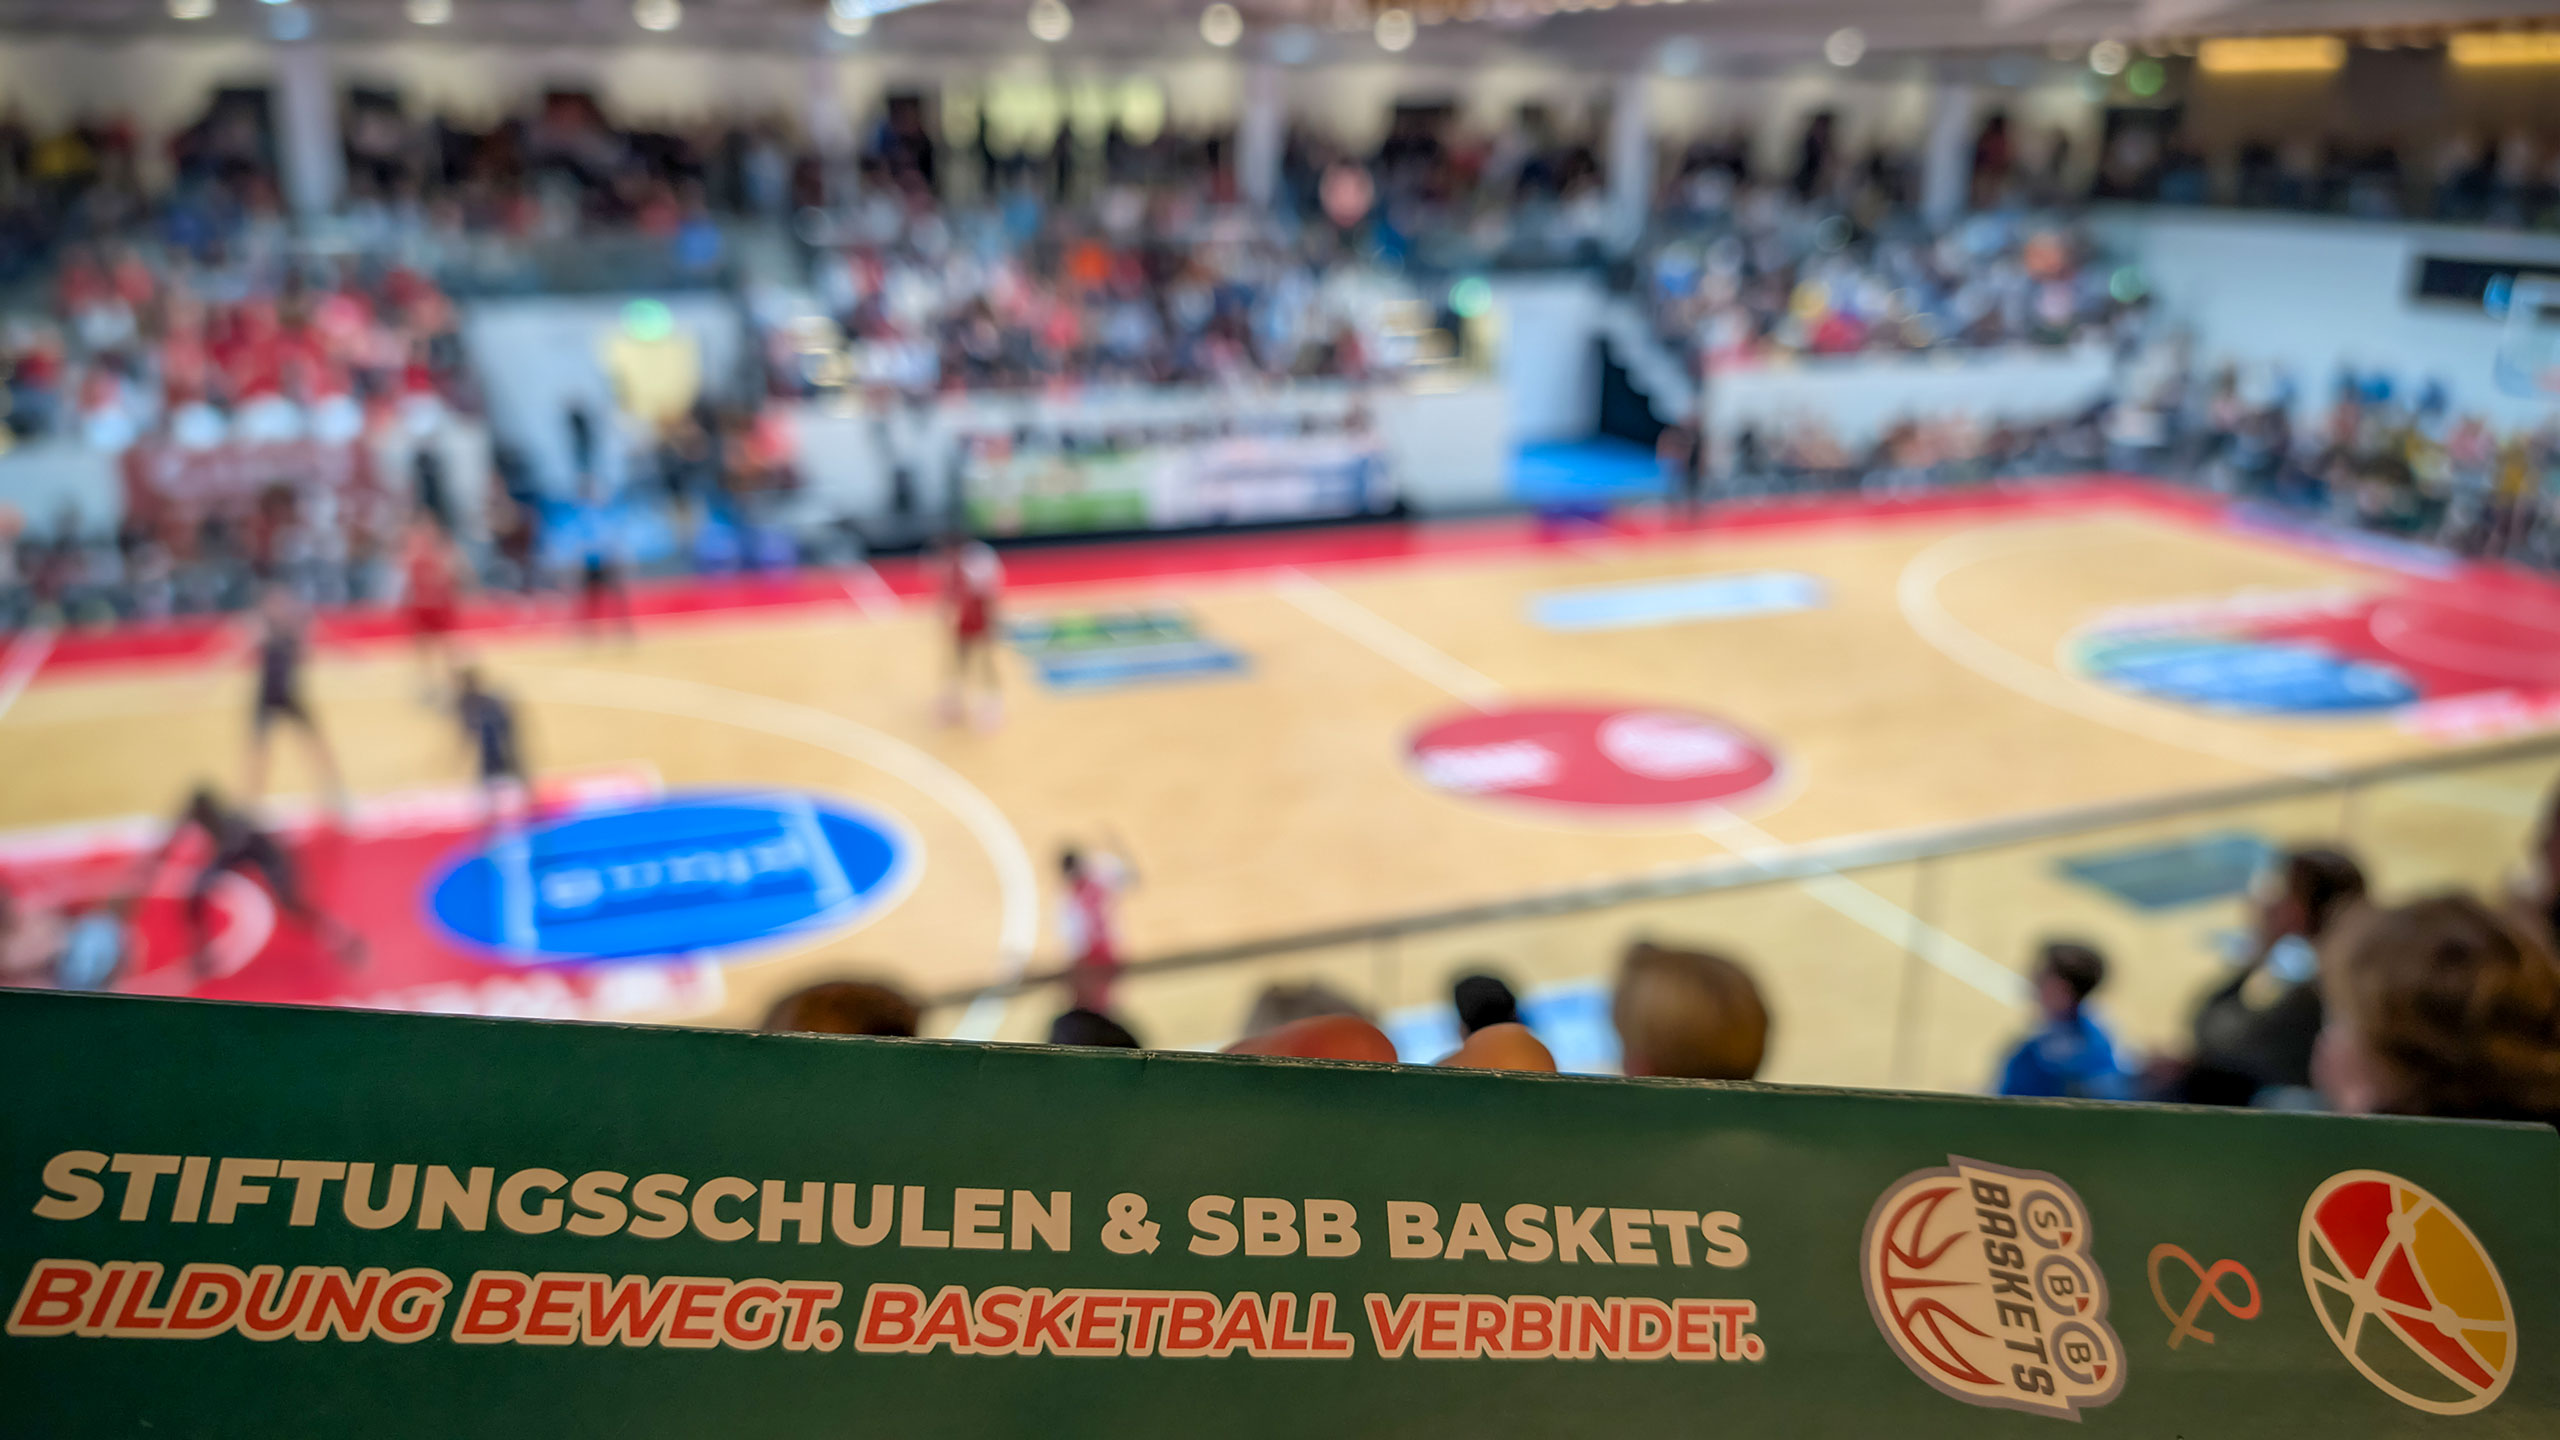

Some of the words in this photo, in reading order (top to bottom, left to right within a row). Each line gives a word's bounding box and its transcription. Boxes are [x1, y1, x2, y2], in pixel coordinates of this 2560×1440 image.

[33, 1150, 1072, 1252] STIFTUNGSSCHULEN
[1101, 1192, 1160, 1253] &
[1188, 1196, 1362, 1258] SBB
[1388, 1201, 1749, 1268] BASKETS
[16, 1265, 446, 1336] BILDUNG
[460, 1276, 840, 1346] BEWEGT.
[860, 1290, 1349, 1353] BASKETBALL
[1374, 1299, 1765, 1358] VERBINDET.
[1969, 1177, 2056, 1397] BASKETS
